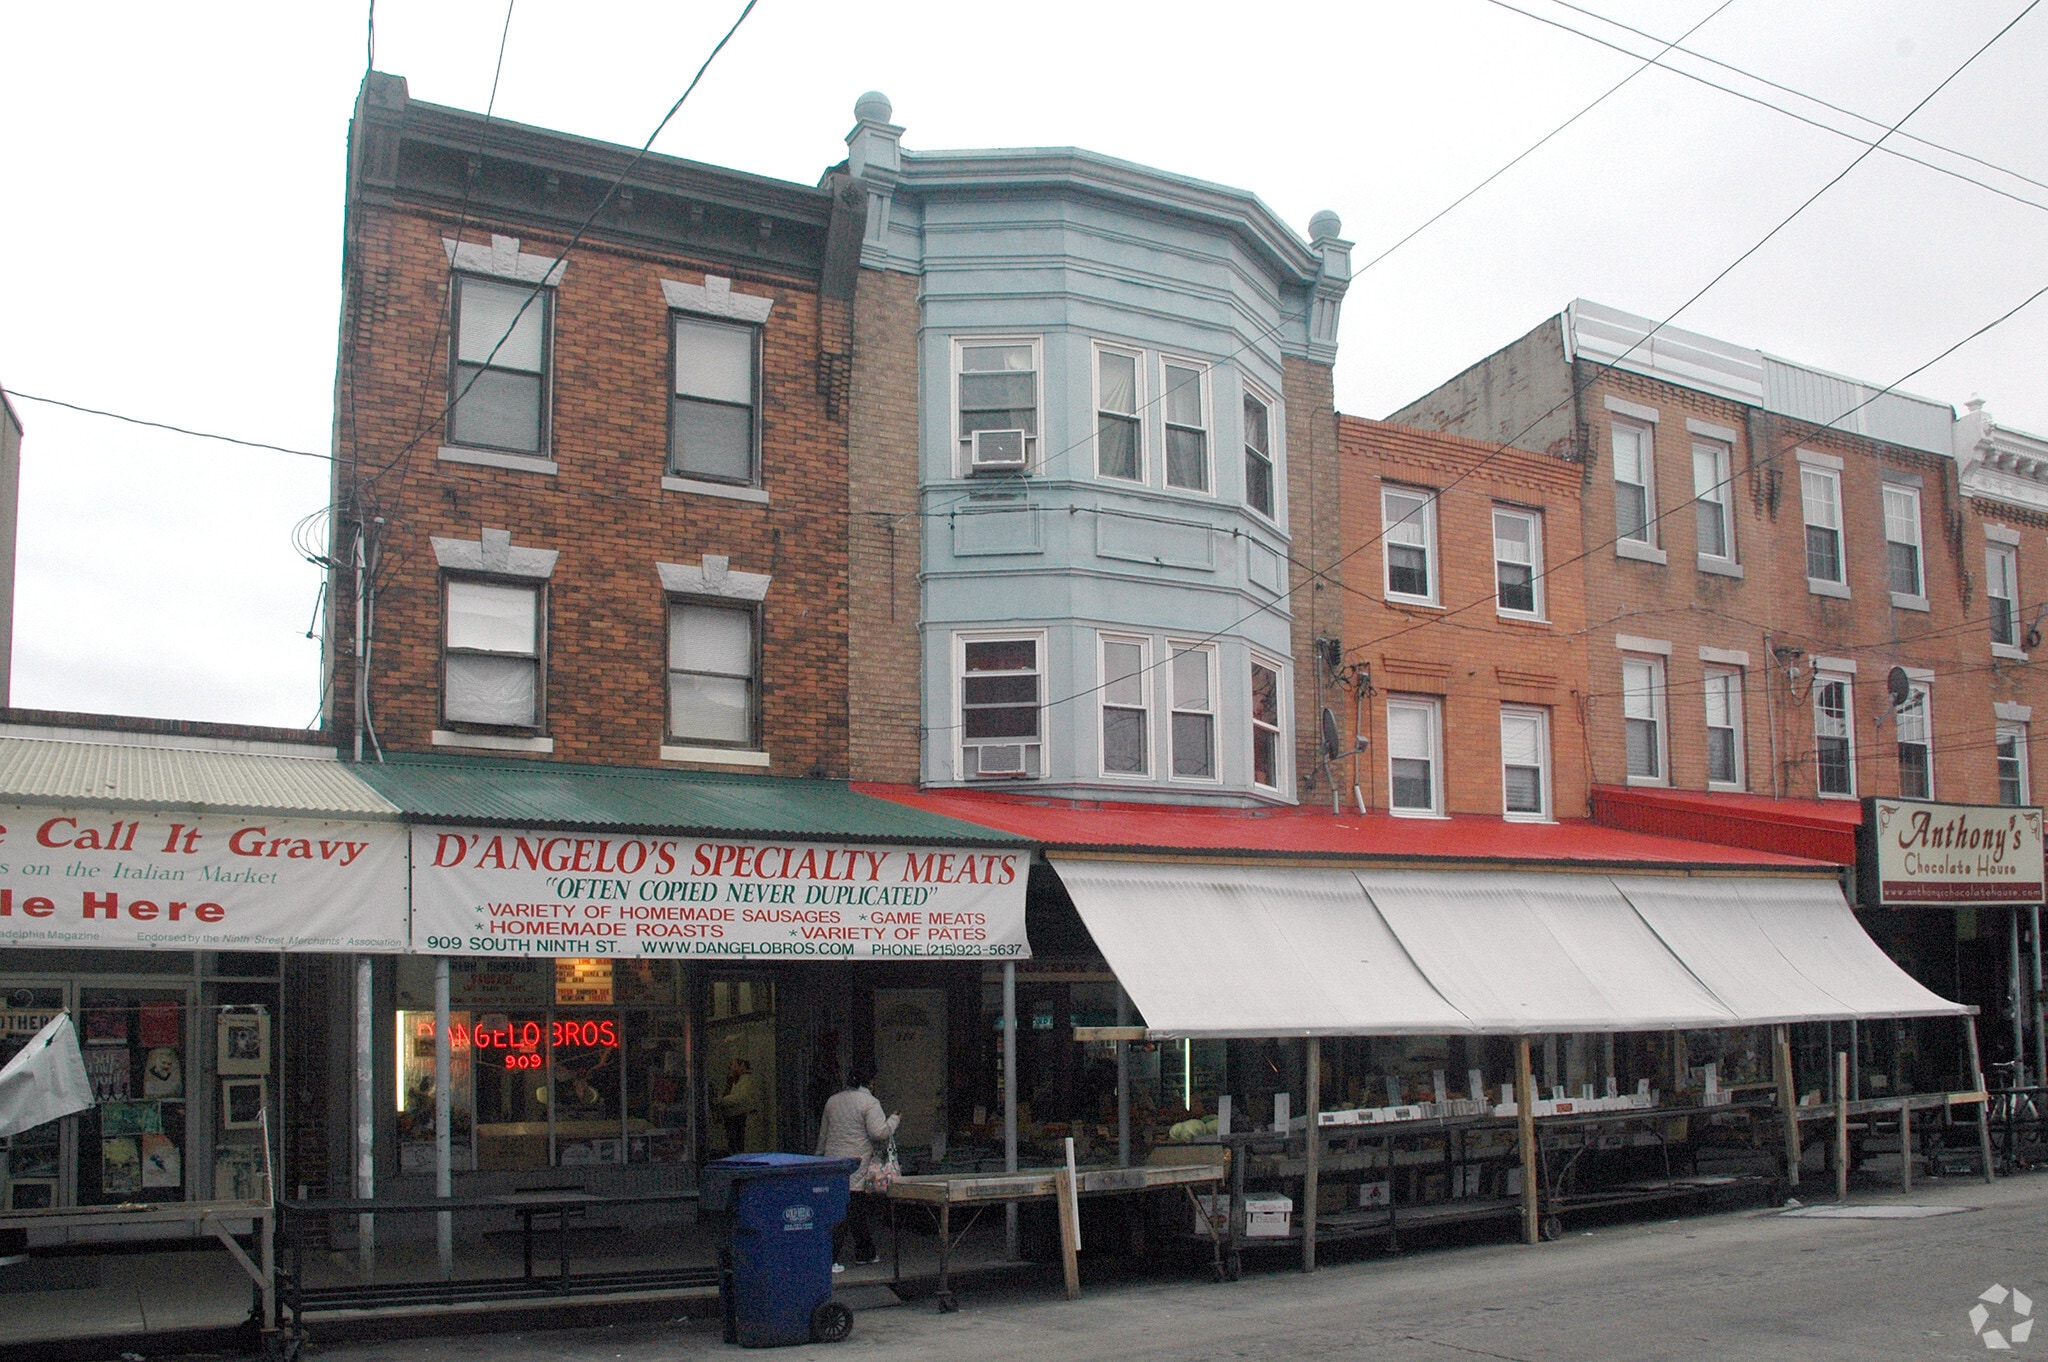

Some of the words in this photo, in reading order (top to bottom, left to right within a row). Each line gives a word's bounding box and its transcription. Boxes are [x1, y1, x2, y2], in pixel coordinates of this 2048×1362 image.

[36, 817, 140, 851] Call
[160, 823, 203, 854] It
[228, 826, 370, 867] Gravy
[1898, 809, 2022, 864] Anthony's
[430, 833, 679, 876] D'ANGELO'S
[690, 843, 892, 882] SPECIALTY
[900, 852, 1018, 885] MEATS
[1904, 851, 1971, 876] Chocolate
[1977, 853, 2017, 878] House
[22, 864, 51, 876] on
[65, 861, 101, 878] the
[112, 862, 185, 881] Italian
[198, 866, 279, 885] Market
[639, 880, 718, 902] COPIED
[726, 882, 796, 904] NEVER
[82, 892, 226, 924] Here
[488, 903, 577, 919] VARIETY
[584, 905, 612, 920] OF
[620, 905, 735, 921] HOMEMADE
[742, 909, 842, 924] SAUSAGES
[871, 912, 922, 925] GAME
[929, 912, 986, 926] MEATS
[47, 930, 100, 941] Magazine
[136, 932, 186, 942] Endorsed
[187, 934, 201, 944] by
[203, 934, 220, 943] the
[222, 934, 250, 944] Ninth
[254, 935, 285, 945] Street
[347, 937, 402, 947] Association
[490, 920, 627, 936] HOMEMADE
[636, 924, 724, 938] ROASTS
[801, 926, 887, 941] VARIETY
[894, 927, 921, 941] OF
[427, 936, 462, 949] 909
[469, 937, 530, 951] SOUTH
[536, 940, 589, 952] NINTH
[595, 940, 622, 953] ST.
[642, 940, 855, 956] WWW.DANGELOBROS.COM
[0, 1013, 52, 1029] THER
[552, 1020, 620, 1049] BROS.
[504, 1054, 543, 1069] 909
